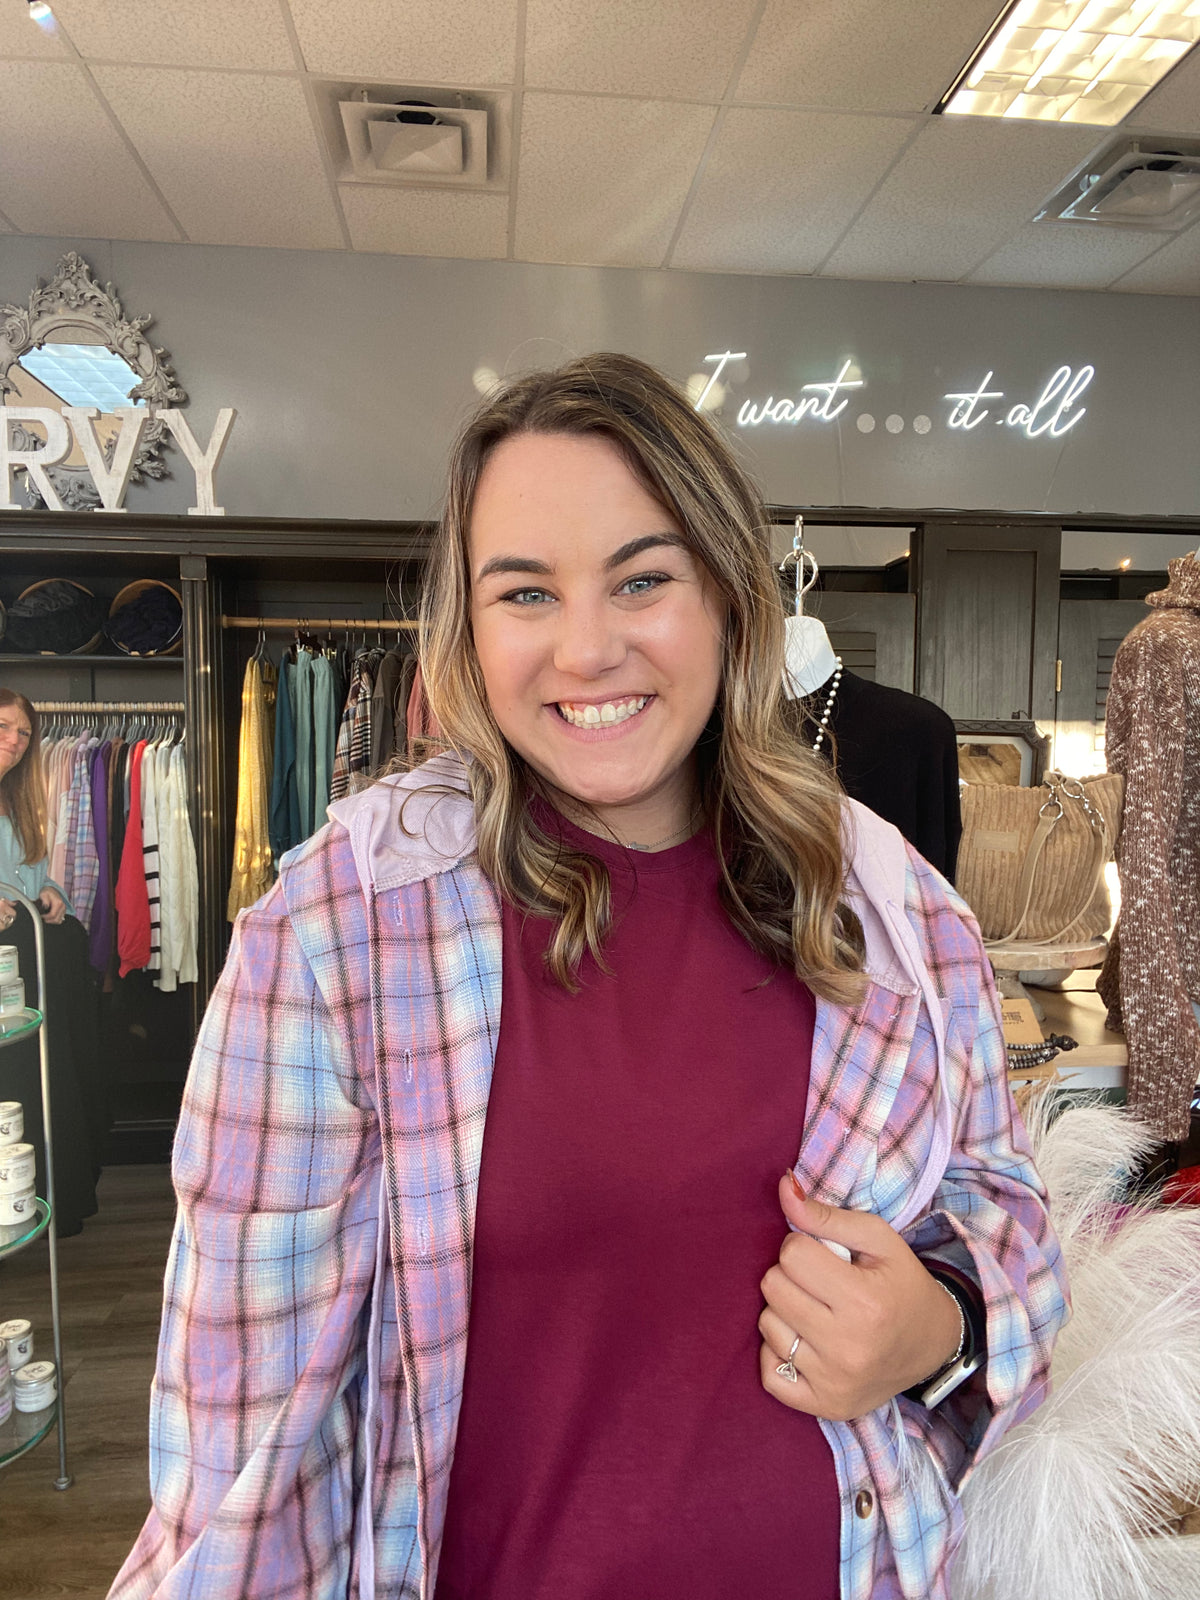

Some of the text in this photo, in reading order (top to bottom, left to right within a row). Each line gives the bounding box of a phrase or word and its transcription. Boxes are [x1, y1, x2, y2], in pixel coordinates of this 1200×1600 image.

[737, 359, 864, 426] want
[944, 370, 1004, 429] it
[1006, 365, 1095, 437] all
[0, 406, 236, 516] RVY
